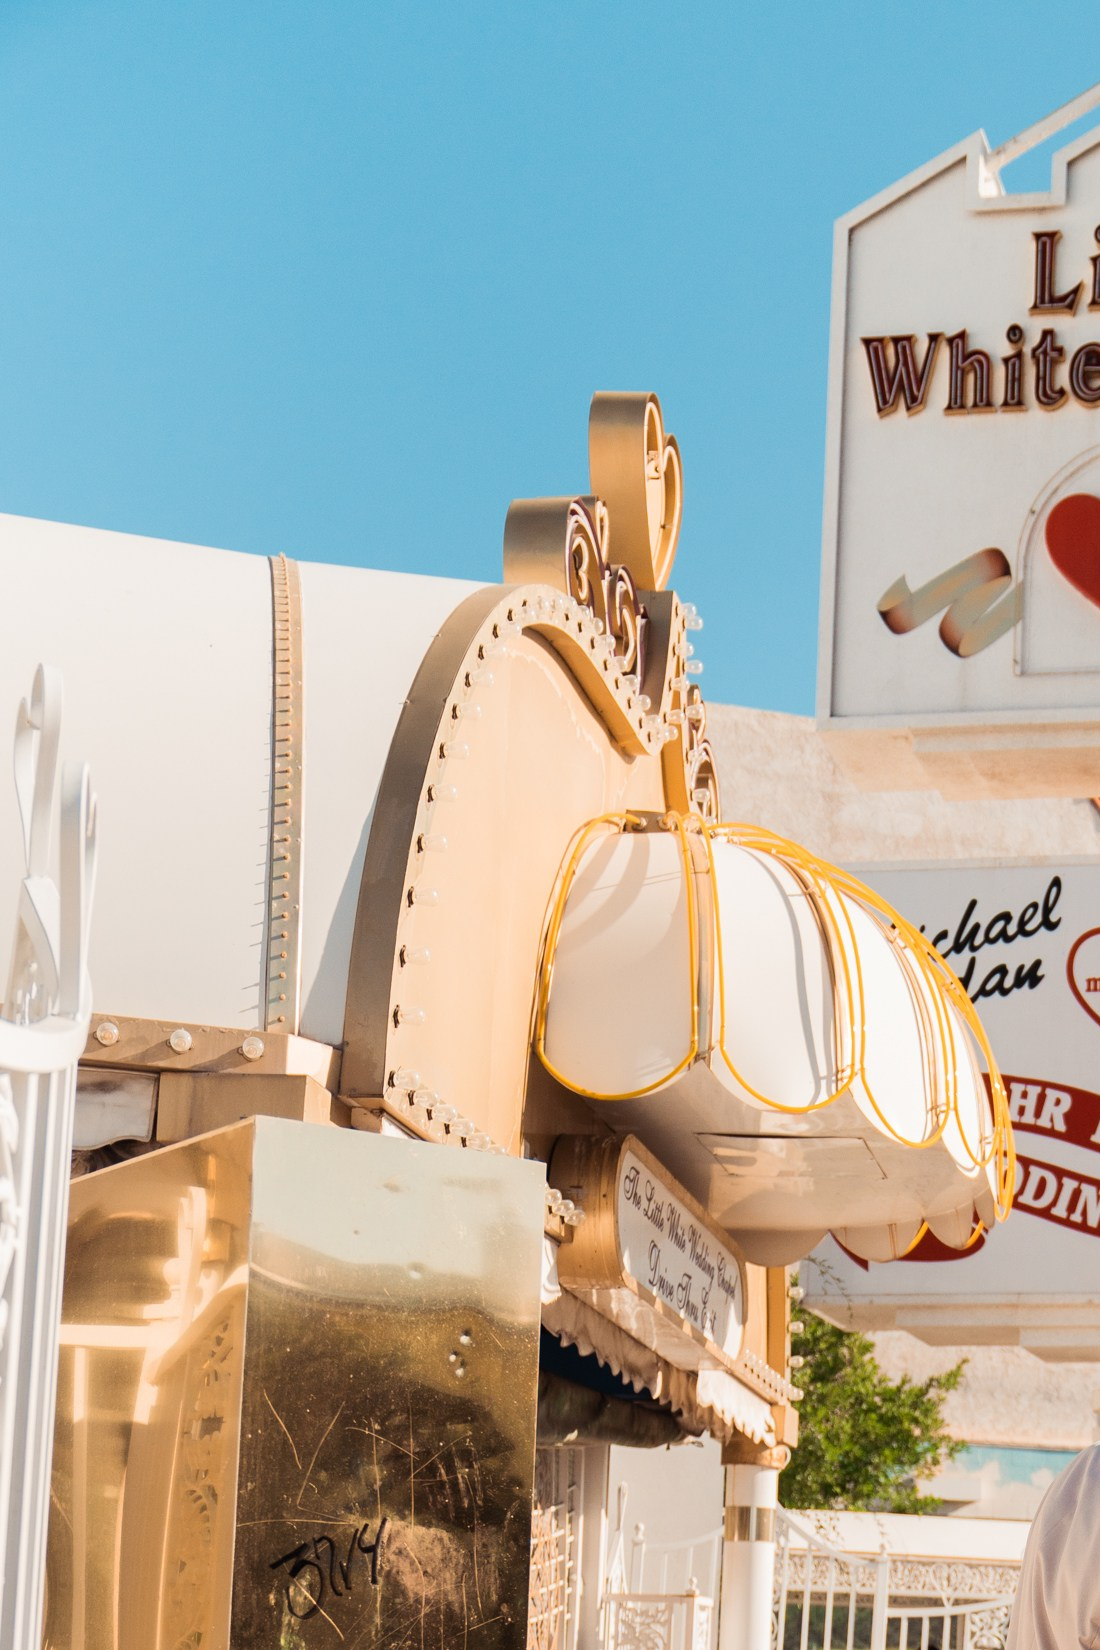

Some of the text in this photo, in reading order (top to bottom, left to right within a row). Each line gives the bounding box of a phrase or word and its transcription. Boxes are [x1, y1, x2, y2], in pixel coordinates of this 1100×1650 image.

[920, 876, 1062, 961] chael
[623, 1166, 642, 1211] The
[643, 1179, 665, 1233] Little
[666, 1202, 687, 1254] White
[687, 1224, 715, 1305] Wedding
[648, 1239, 675, 1302] Drive
